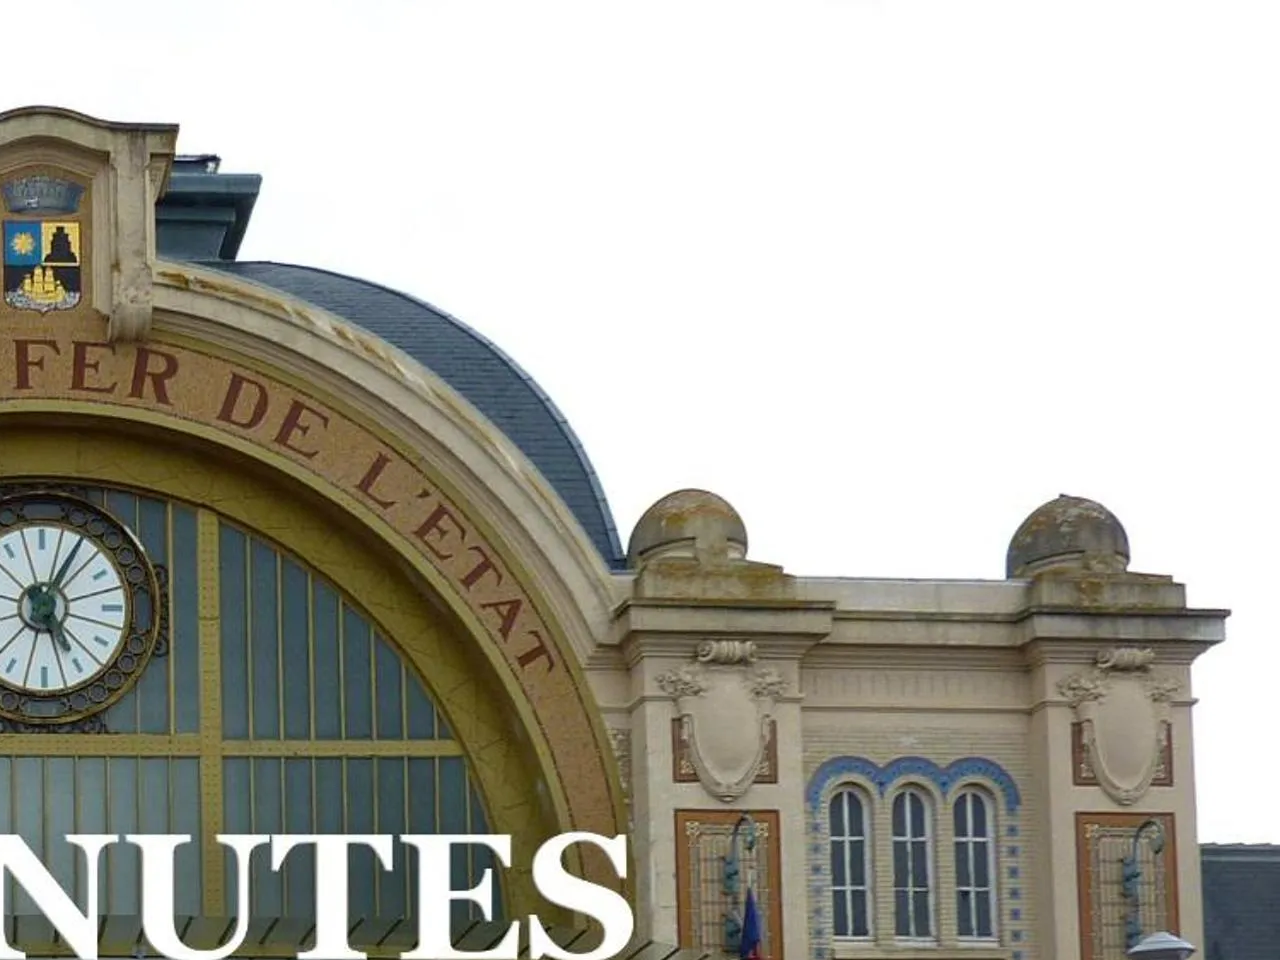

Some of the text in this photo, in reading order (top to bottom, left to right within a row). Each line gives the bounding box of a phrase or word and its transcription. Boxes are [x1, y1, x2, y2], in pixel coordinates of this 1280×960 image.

[13, 338, 180, 405] FER
[220, 371, 330, 460] DE
[355, 450, 555, 676] L'ETAT
